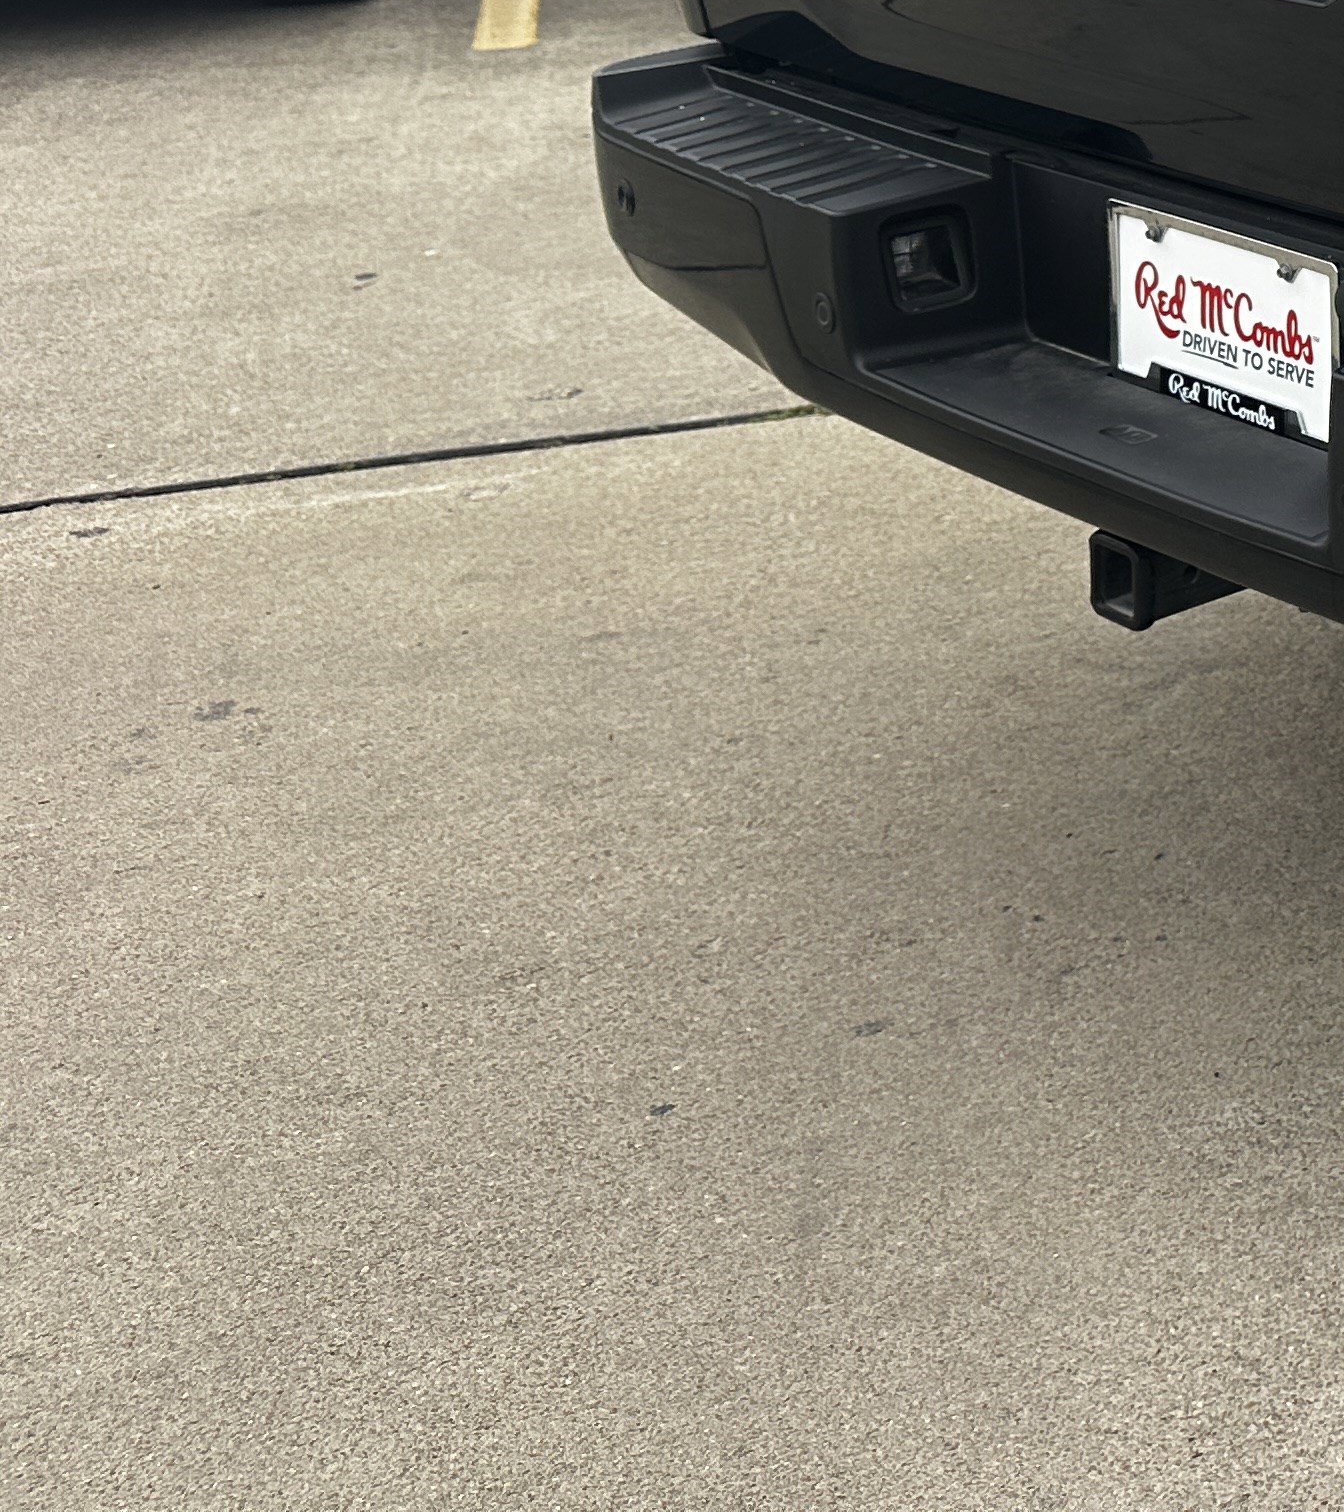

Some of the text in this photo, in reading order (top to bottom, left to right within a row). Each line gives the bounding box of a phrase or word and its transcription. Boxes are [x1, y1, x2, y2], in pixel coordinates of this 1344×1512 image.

[1135, 261, 1187, 339] Red
[1190, 276, 1314, 365] McCombs
[1182, 330, 1315, 388] DRIVEN TO SERVE
[1168, 373, 1276, 429] Red McCombs
